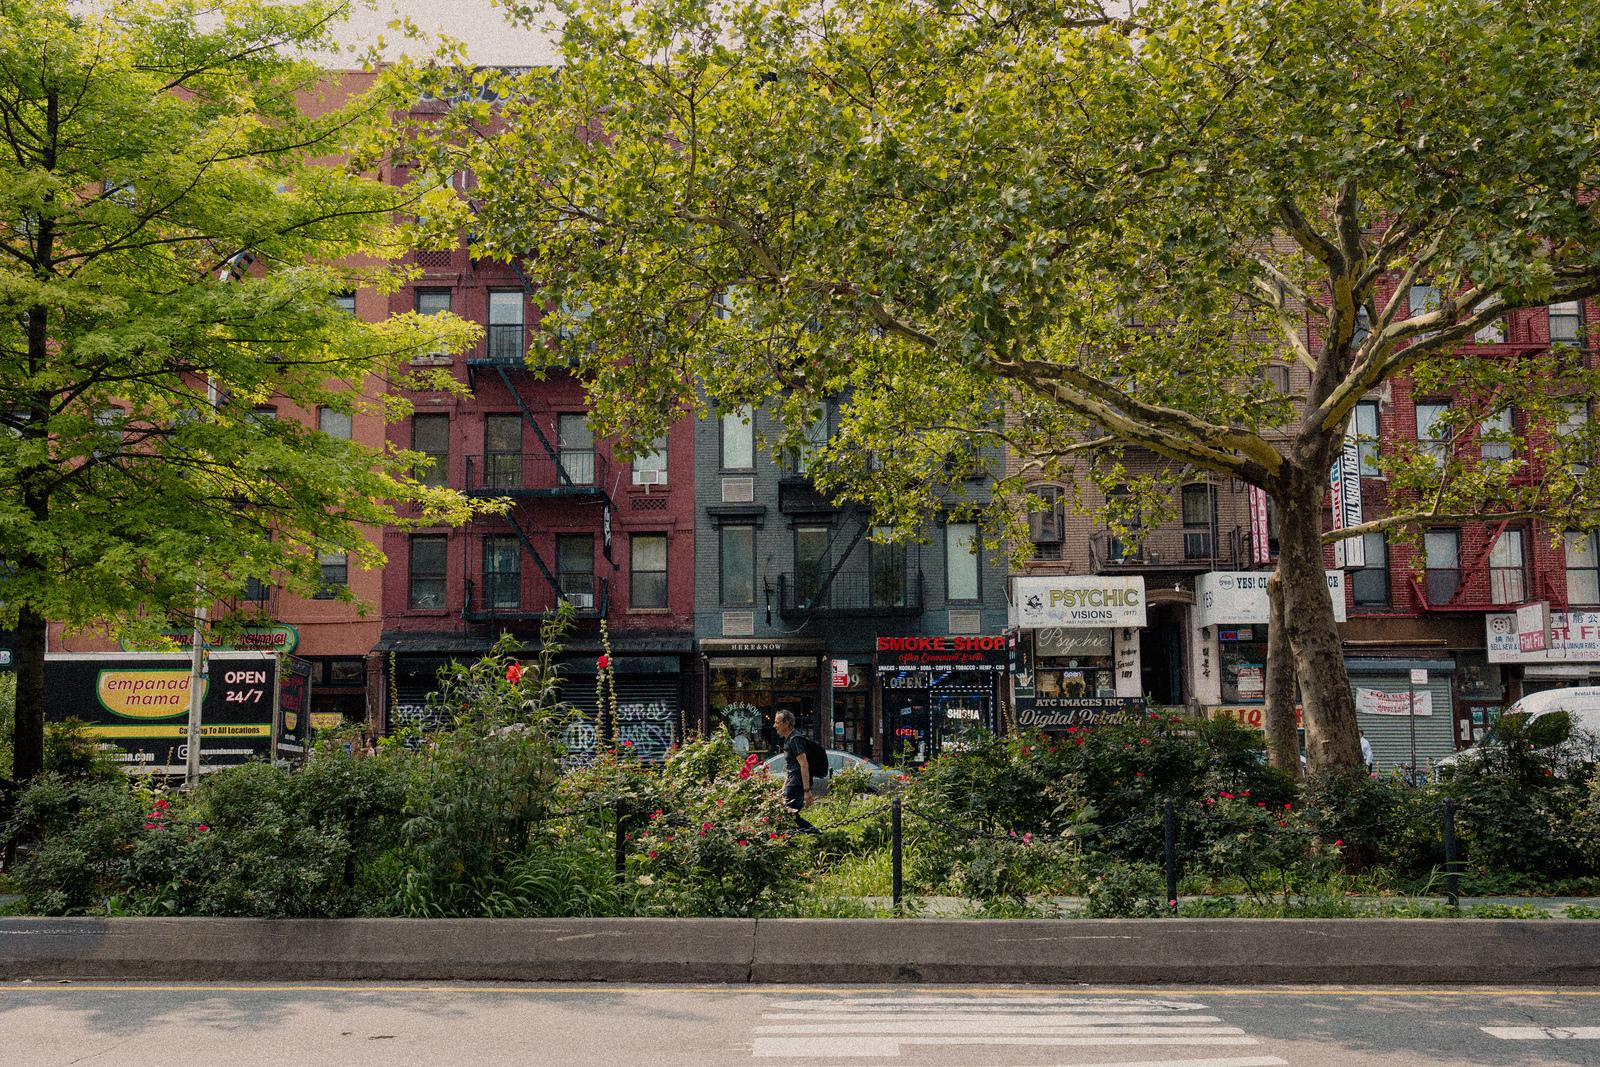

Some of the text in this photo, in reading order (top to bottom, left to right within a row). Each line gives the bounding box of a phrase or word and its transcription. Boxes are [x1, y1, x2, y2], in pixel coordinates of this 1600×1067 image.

[1343, 447, 1358, 472] NEW
[1344, 471, 1359, 503] YORK
[1236, 577, 1255, 589] YES!
[1050, 589, 1139, 607] PSYCHIC
[1071, 610, 1113, 619] VISIONS
[878, 636, 1006, 650] SMOKE SHOP
[1039, 627, 1107, 654] Psychic
[1520, 634, 1544, 650] Flat Fix
[107, 675, 192, 692] empanad
[224, 671, 266, 684] OPEN
[890, 677, 924, 688] OPEN
[126, 694, 180, 705] mama
[226, 690, 263, 703] 24/7
[1370, 690, 1389, 698] FOR
[720, 701, 739, 717] HERE
[746, 703, 762, 717] NOW
[1035, 699, 1126, 707] ATC IMAGES INC.
[1019, 709, 1075, 729] Digital
[179, 727, 208, 735] Cang
[228, 726, 260, 734] Locations
